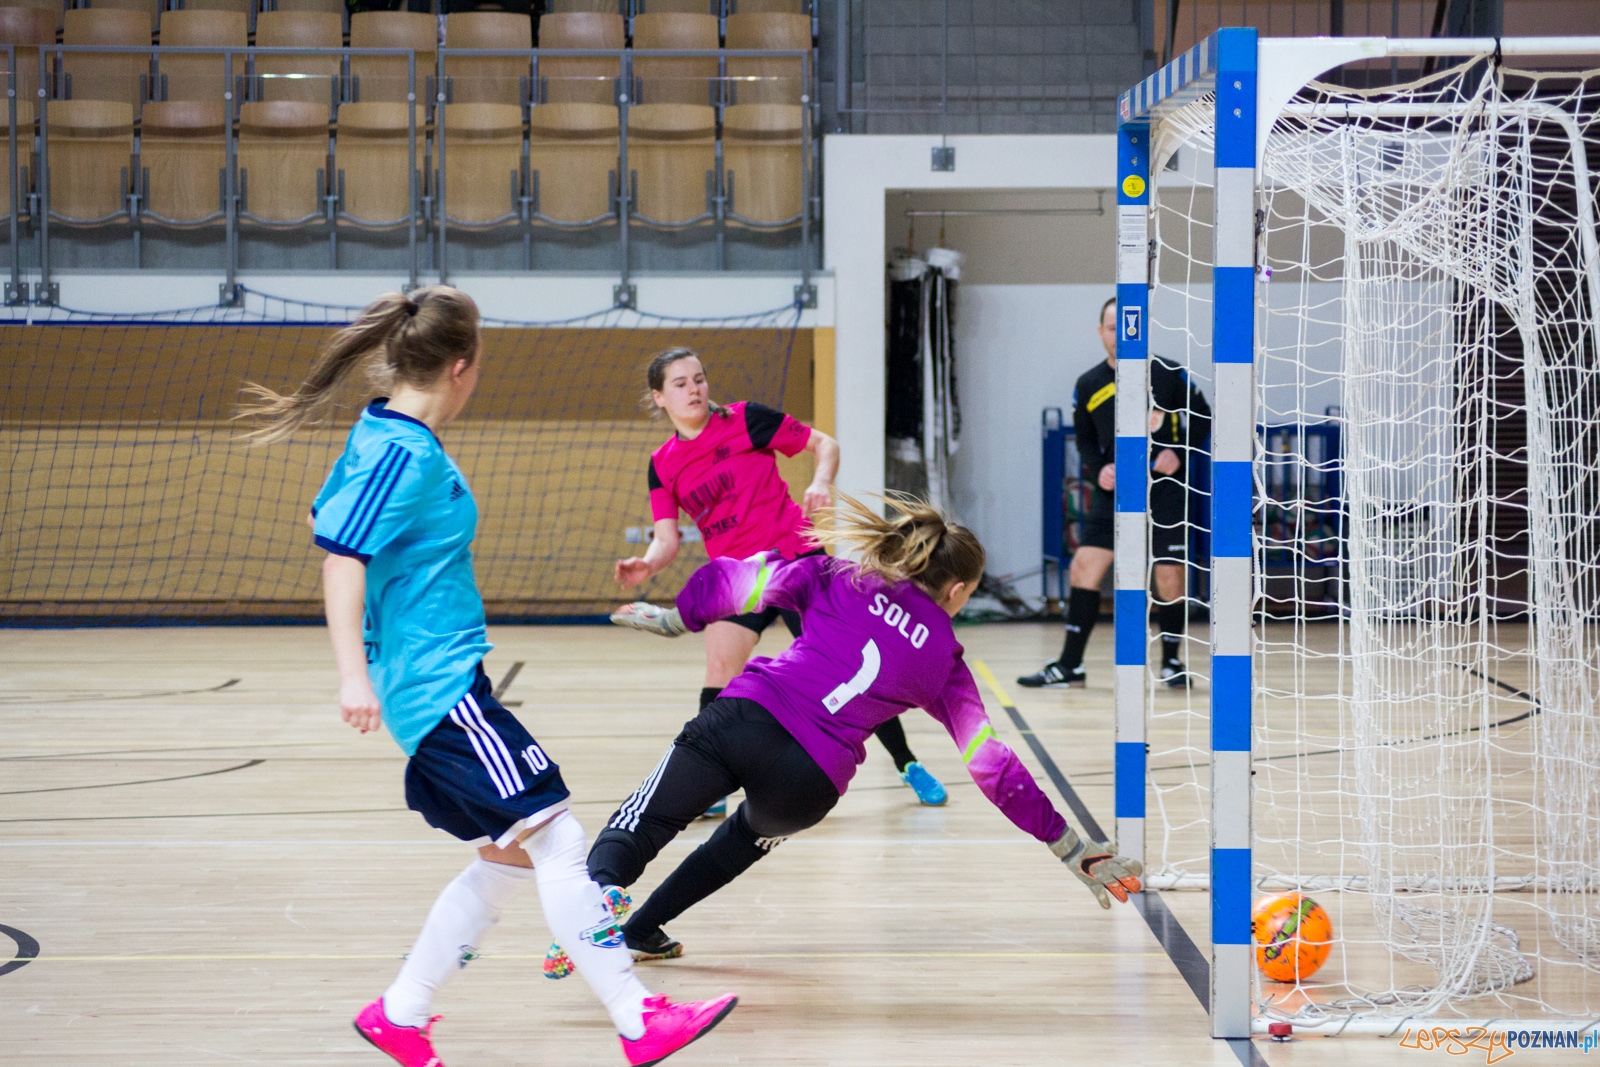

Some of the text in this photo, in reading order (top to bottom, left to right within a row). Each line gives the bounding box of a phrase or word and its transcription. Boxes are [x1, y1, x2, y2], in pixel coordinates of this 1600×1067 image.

[868, 593, 930, 649] SOLO
[821, 637, 881, 715] 1
[521, 744, 549, 775] 10
